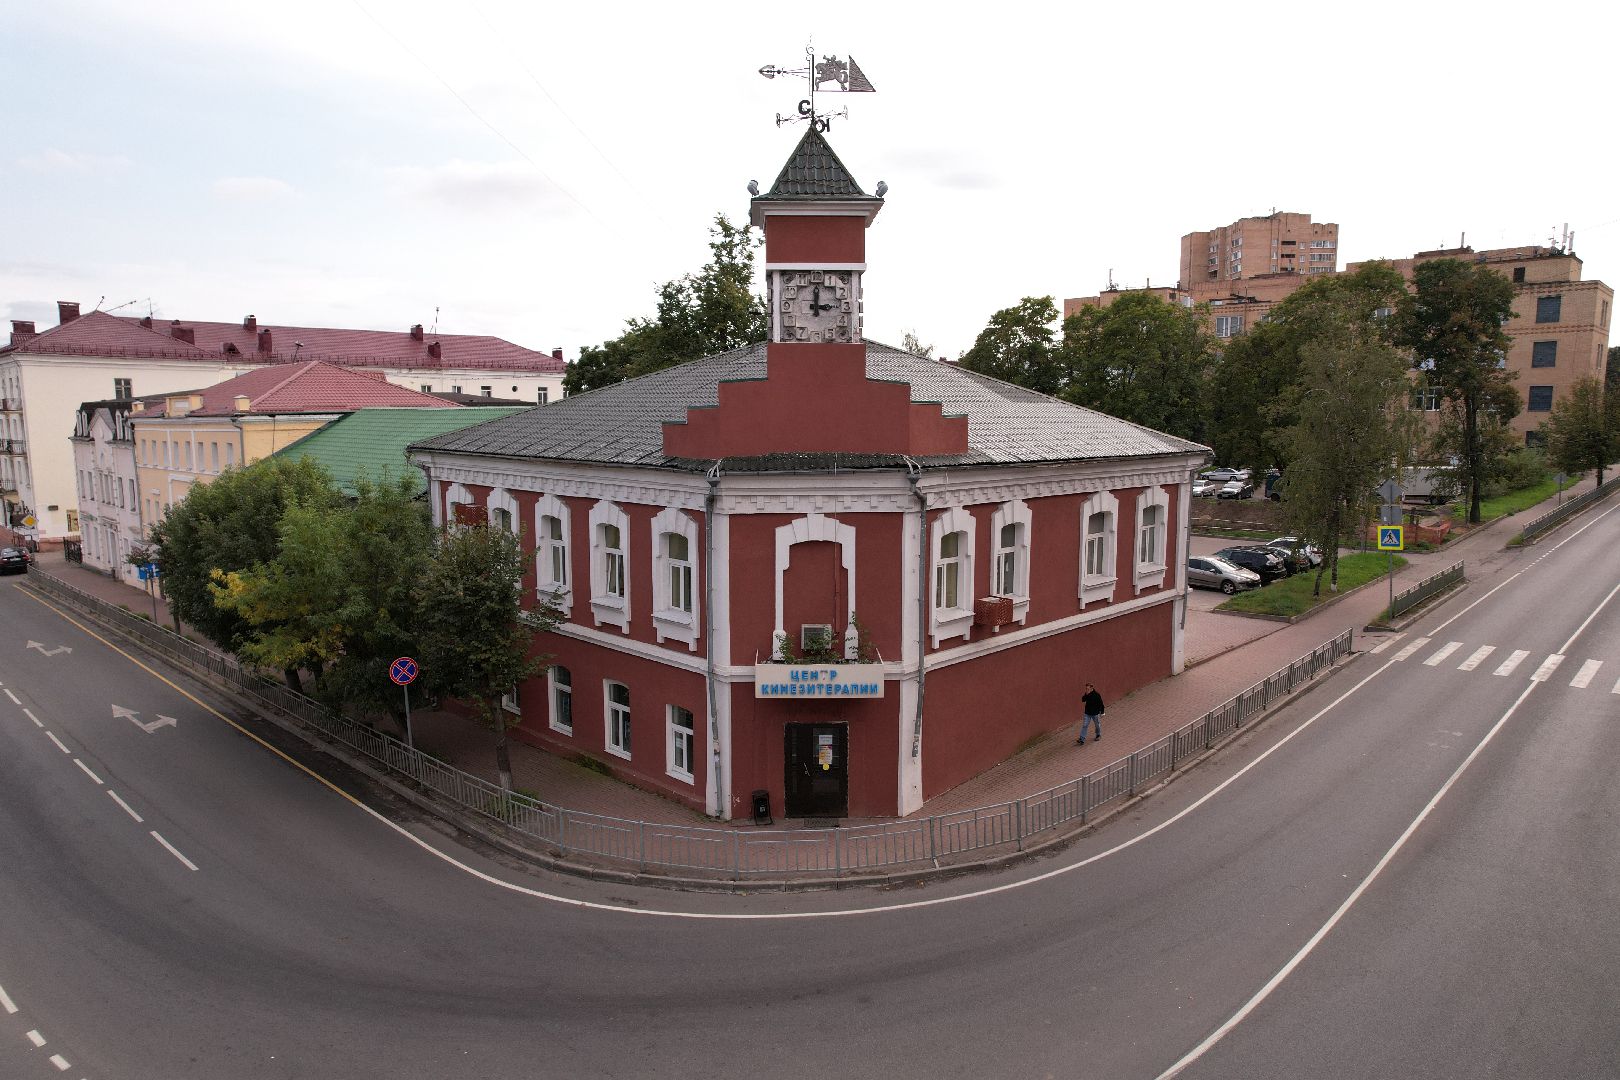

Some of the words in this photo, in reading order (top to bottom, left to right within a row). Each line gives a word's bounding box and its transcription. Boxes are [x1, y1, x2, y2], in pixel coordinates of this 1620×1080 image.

[798, 274, 807, 284] 11
[786, 287, 796, 297] 10
[840, 288, 846, 297] 2
[783, 302, 790, 310] 9
[843, 302, 850, 311] 3
[839, 316, 846, 325] 4
[799, 328, 806, 338] 7
[828, 329, 833, 338] 5
[790, 670, 837, 682] ЦЕНТР
[761, 684, 879, 695] КИНЕЗИТЕРАПИИ
